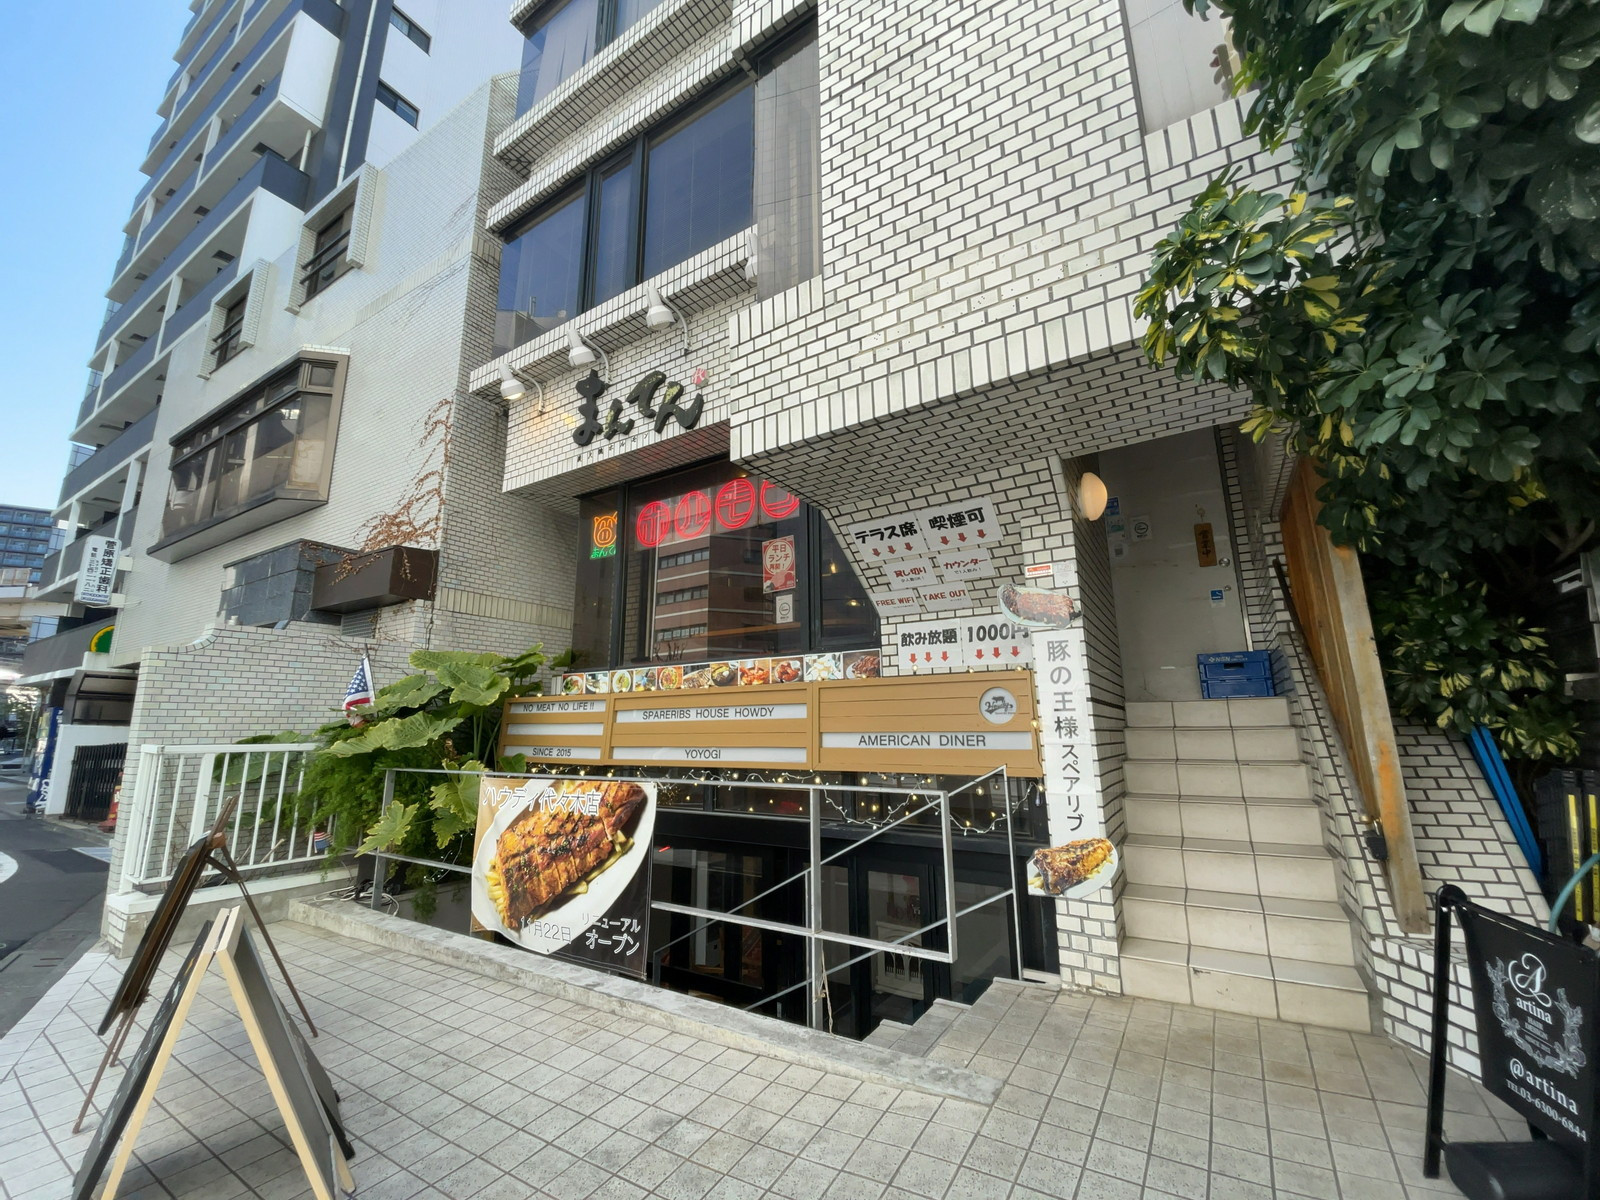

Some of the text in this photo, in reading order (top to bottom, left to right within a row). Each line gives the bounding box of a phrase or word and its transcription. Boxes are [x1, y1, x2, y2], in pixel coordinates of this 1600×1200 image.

[573, 368, 705, 447] まんてん
[928, 506, 985, 531] 喫煙可
[854, 521, 918, 544] テラス席
[768, 553, 790, 563] ランチ
[772, 544, 787, 553] 平日
[96, 540, 117, 594] 菅原矯正歯科
[893, 566, 927, 578] 貸し切り
[943, 558, 988, 570] カウンター
[876, 598, 896, 607] FREE
[897, 596, 915, 605] WIFI
[922, 592, 947, 602] TAKE
[949, 589, 967, 598] OUT
[900, 627, 958, 647] 飲み放題
[967, 623, 1029, 643] 1000円
[523, 703, 533, 712] NO
[536, 702, 555, 712] MEAT
[558, 702, 569, 711] NO
[642, 707, 775, 720] SPARERIBS HOUSE HOWDY
[858, 734, 986, 747] AMERICAN DINER
[1047, 640, 1085, 833] 豚の王様スペアリブ
[532, 747, 571, 757] SINCE 2015
[685, 749, 721, 759] YOYOGI
[483, 786, 602, 816] ハウディ代々木店
[581, 912, 641, 934] リニューアル
[585, 929, 640, 956] オープン
[1515, 997, 1553, 1025] artina
[1509, 1057, 1579, 1115] @artina
